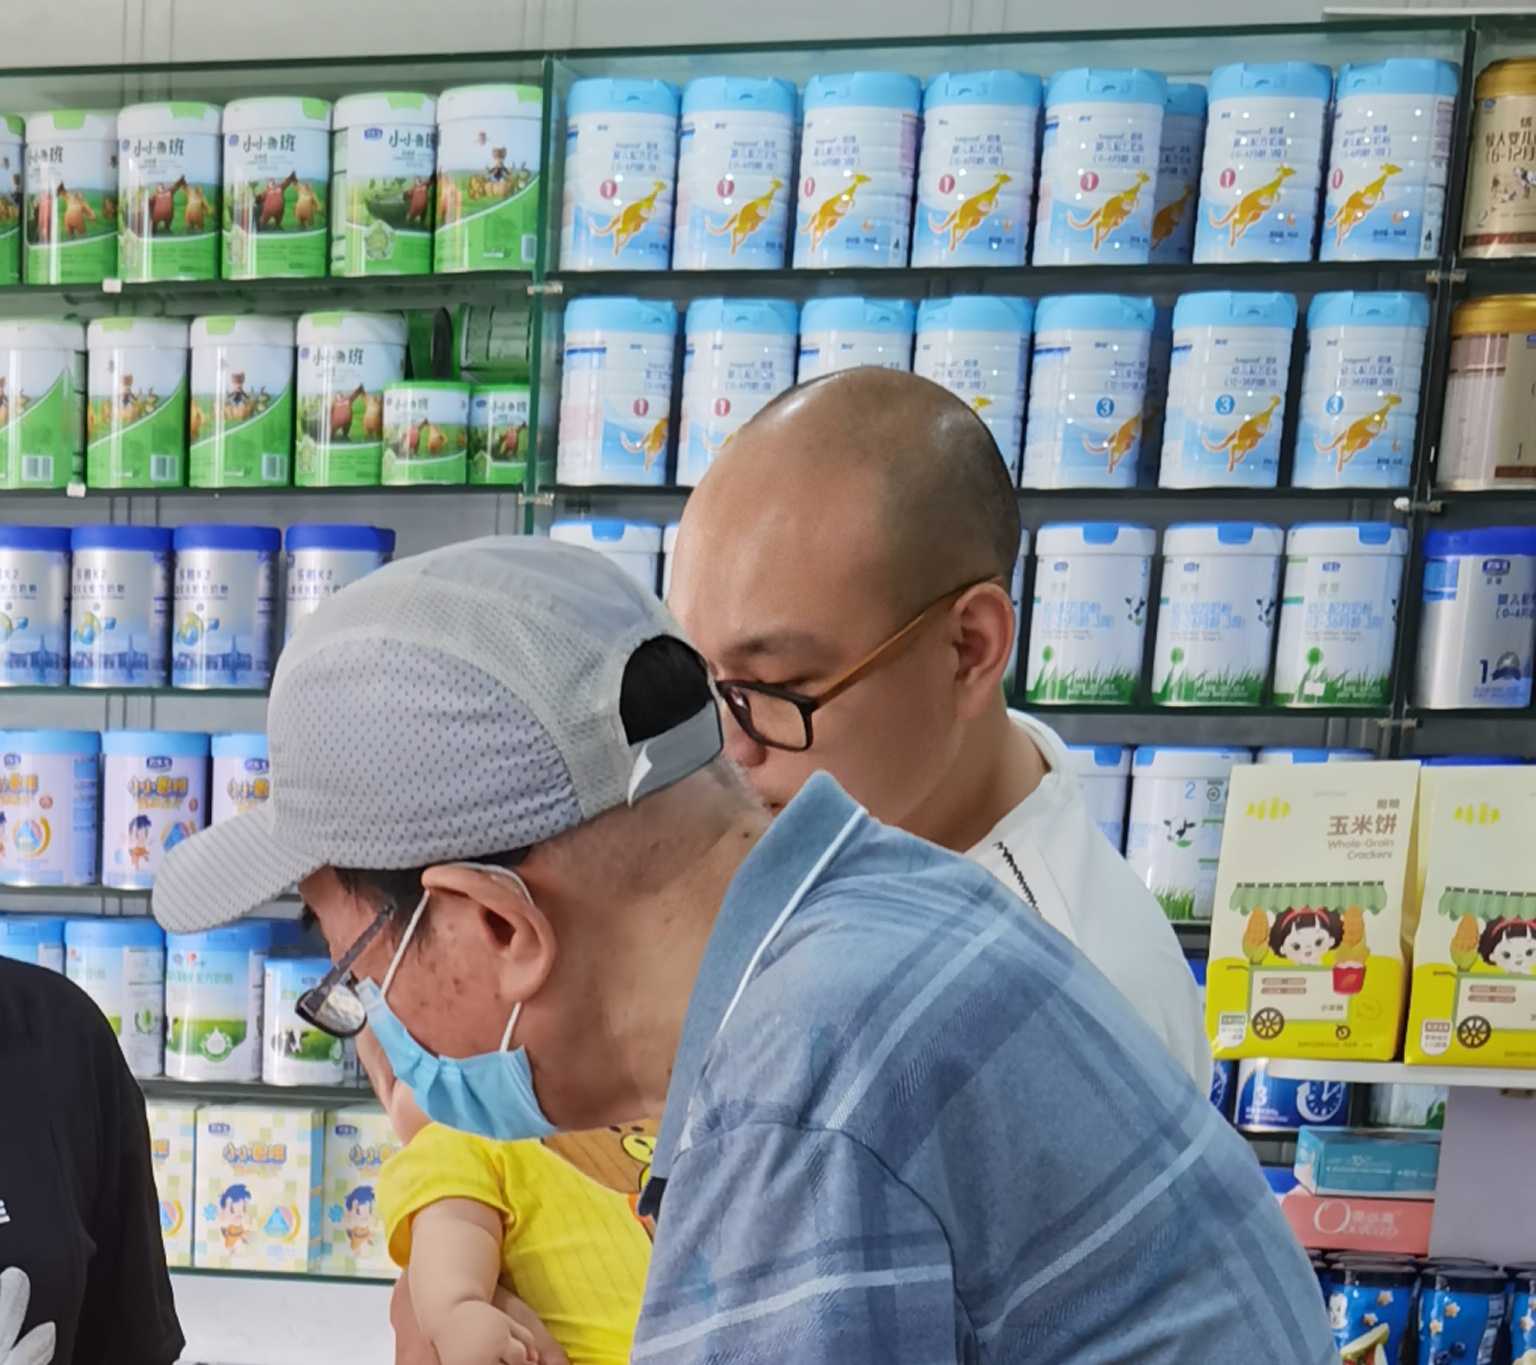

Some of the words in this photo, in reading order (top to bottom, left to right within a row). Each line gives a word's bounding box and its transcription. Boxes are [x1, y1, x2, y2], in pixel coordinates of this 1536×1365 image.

[1185, 780, 1196, 800] 2
[1327, 812, 1397, 836] 玉米饼
[1347, 850, 1393, 860] Crackers
